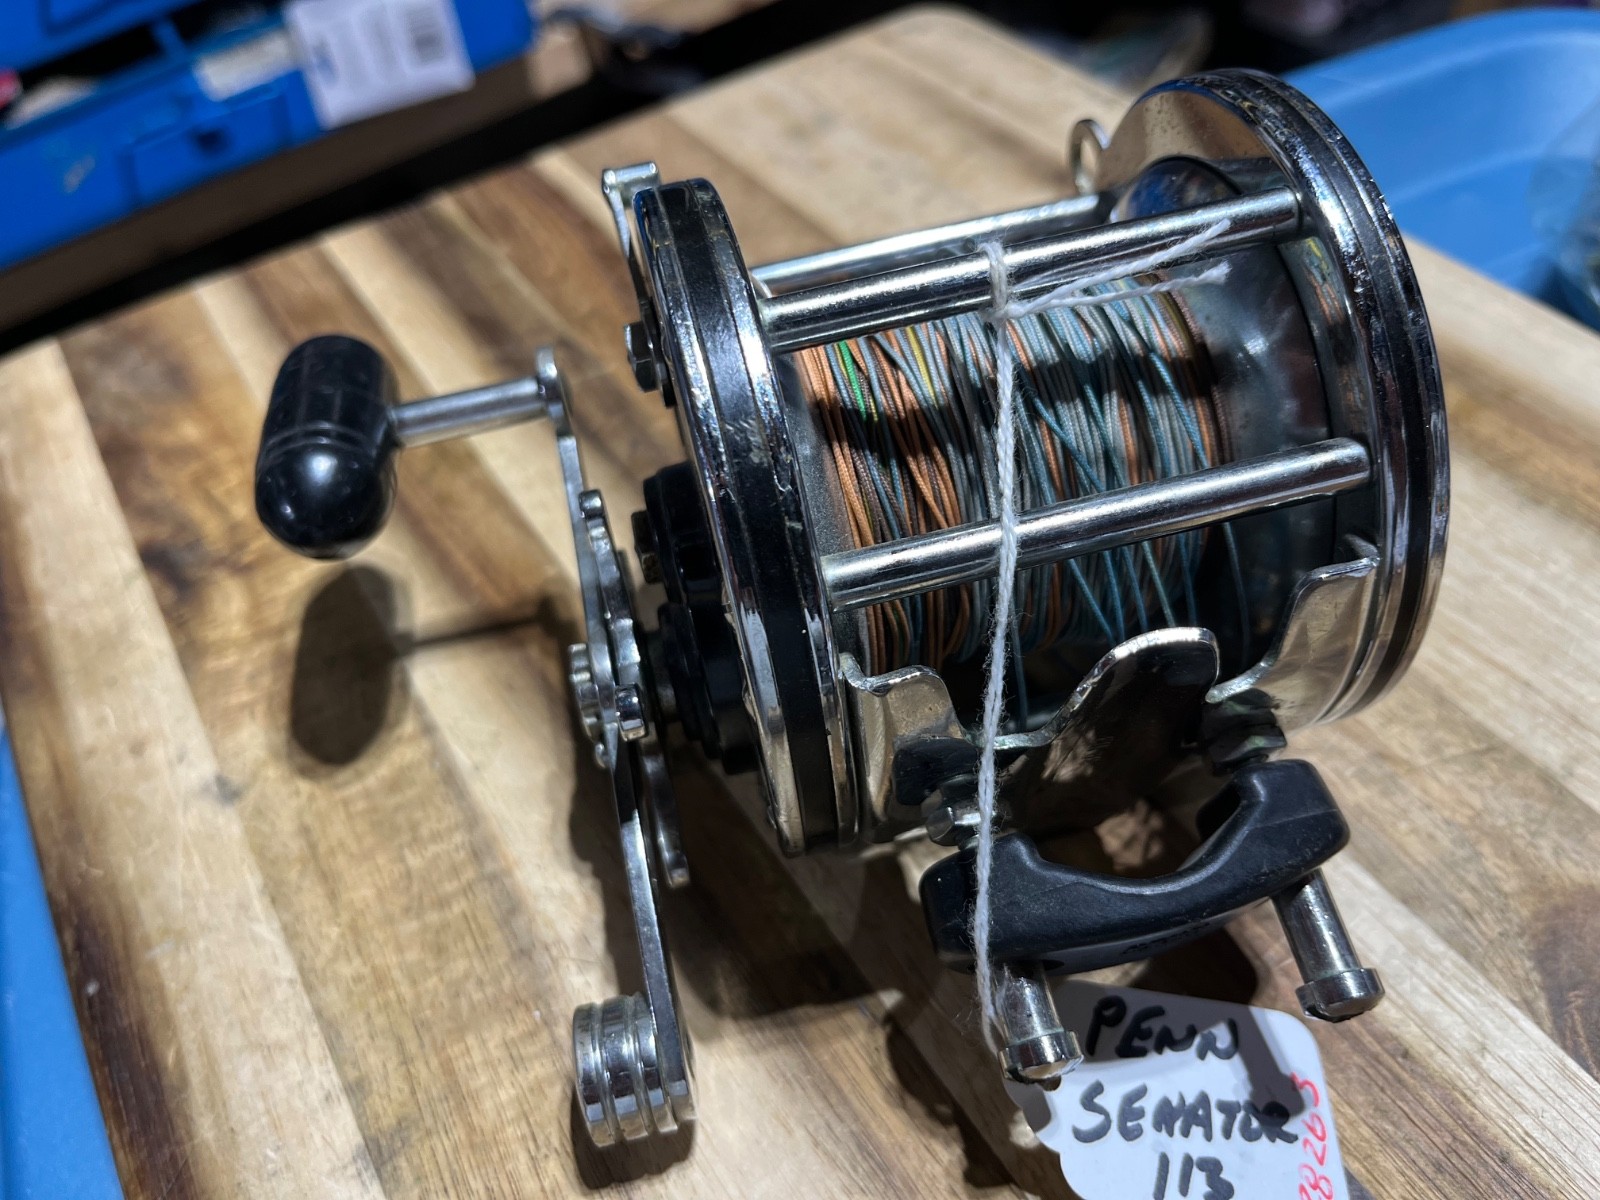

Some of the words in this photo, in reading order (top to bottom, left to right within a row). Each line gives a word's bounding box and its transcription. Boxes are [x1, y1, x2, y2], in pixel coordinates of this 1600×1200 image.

[1085, 995, 1239, 1061] PENN
[1072, 1080, 1299, 1143] SENATOR
[1152, 1151, 1235, 1200] 113
